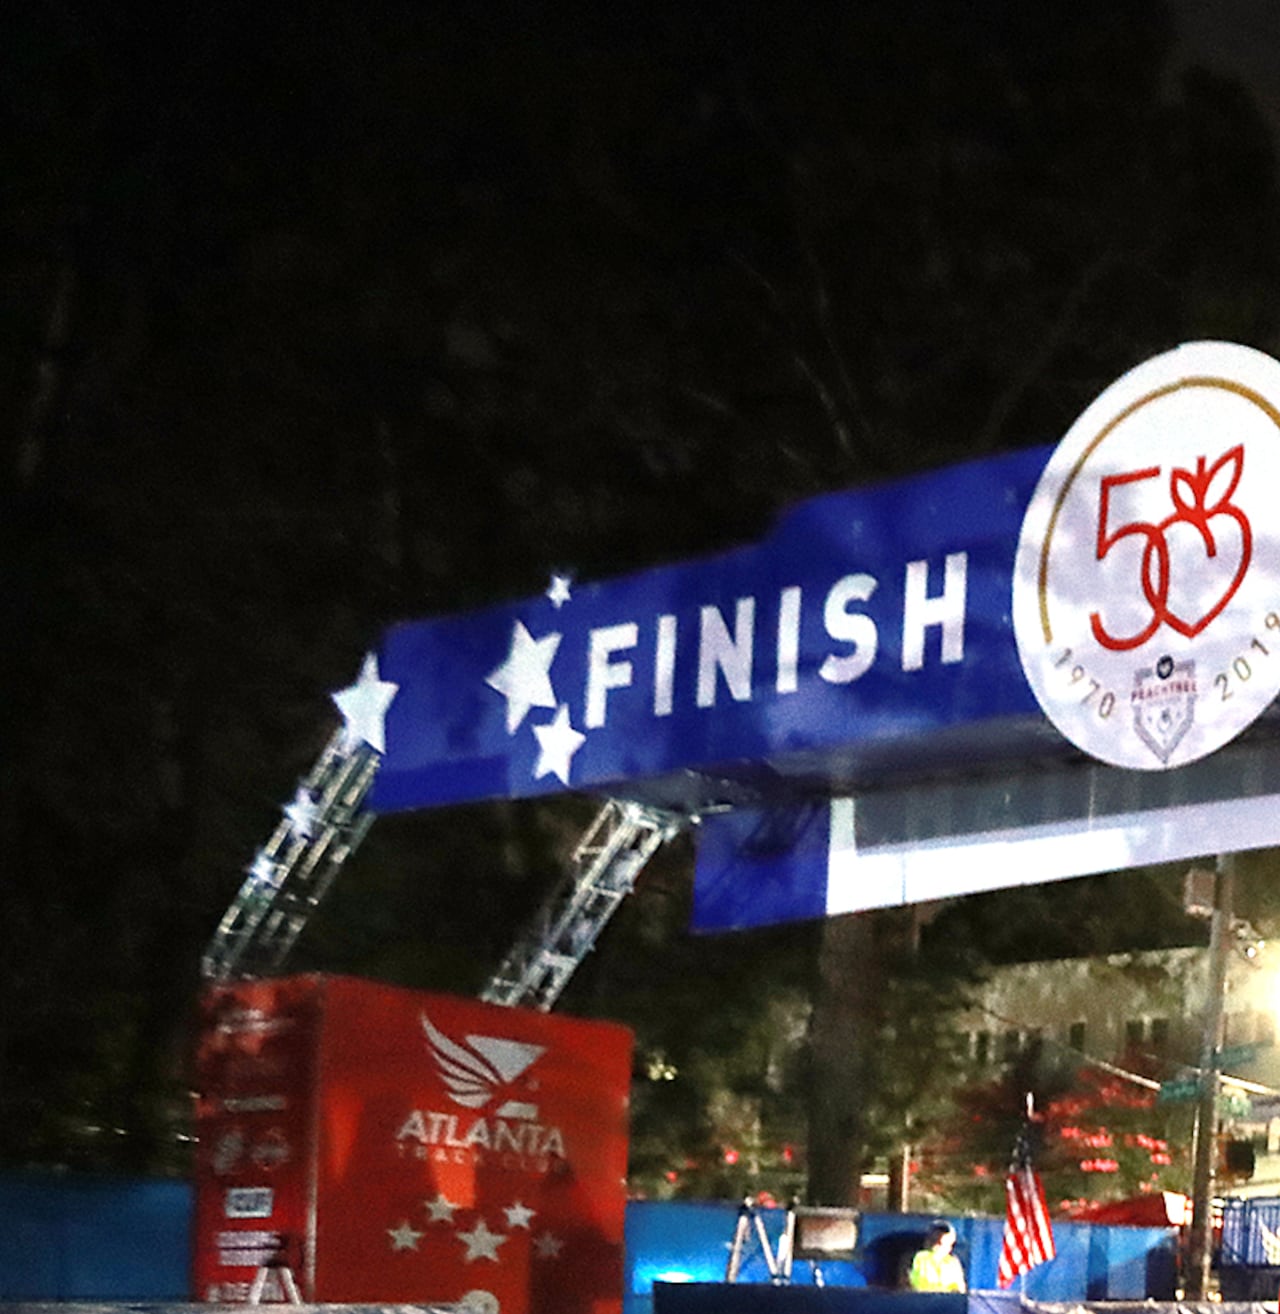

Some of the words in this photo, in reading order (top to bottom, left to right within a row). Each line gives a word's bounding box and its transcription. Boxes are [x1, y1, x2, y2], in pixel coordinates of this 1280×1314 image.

[585, 552, 968, 729] FINISH
[1054, 647, 1116, 719] 1970
[396, 1109, 567, 1160] ATLANTA
